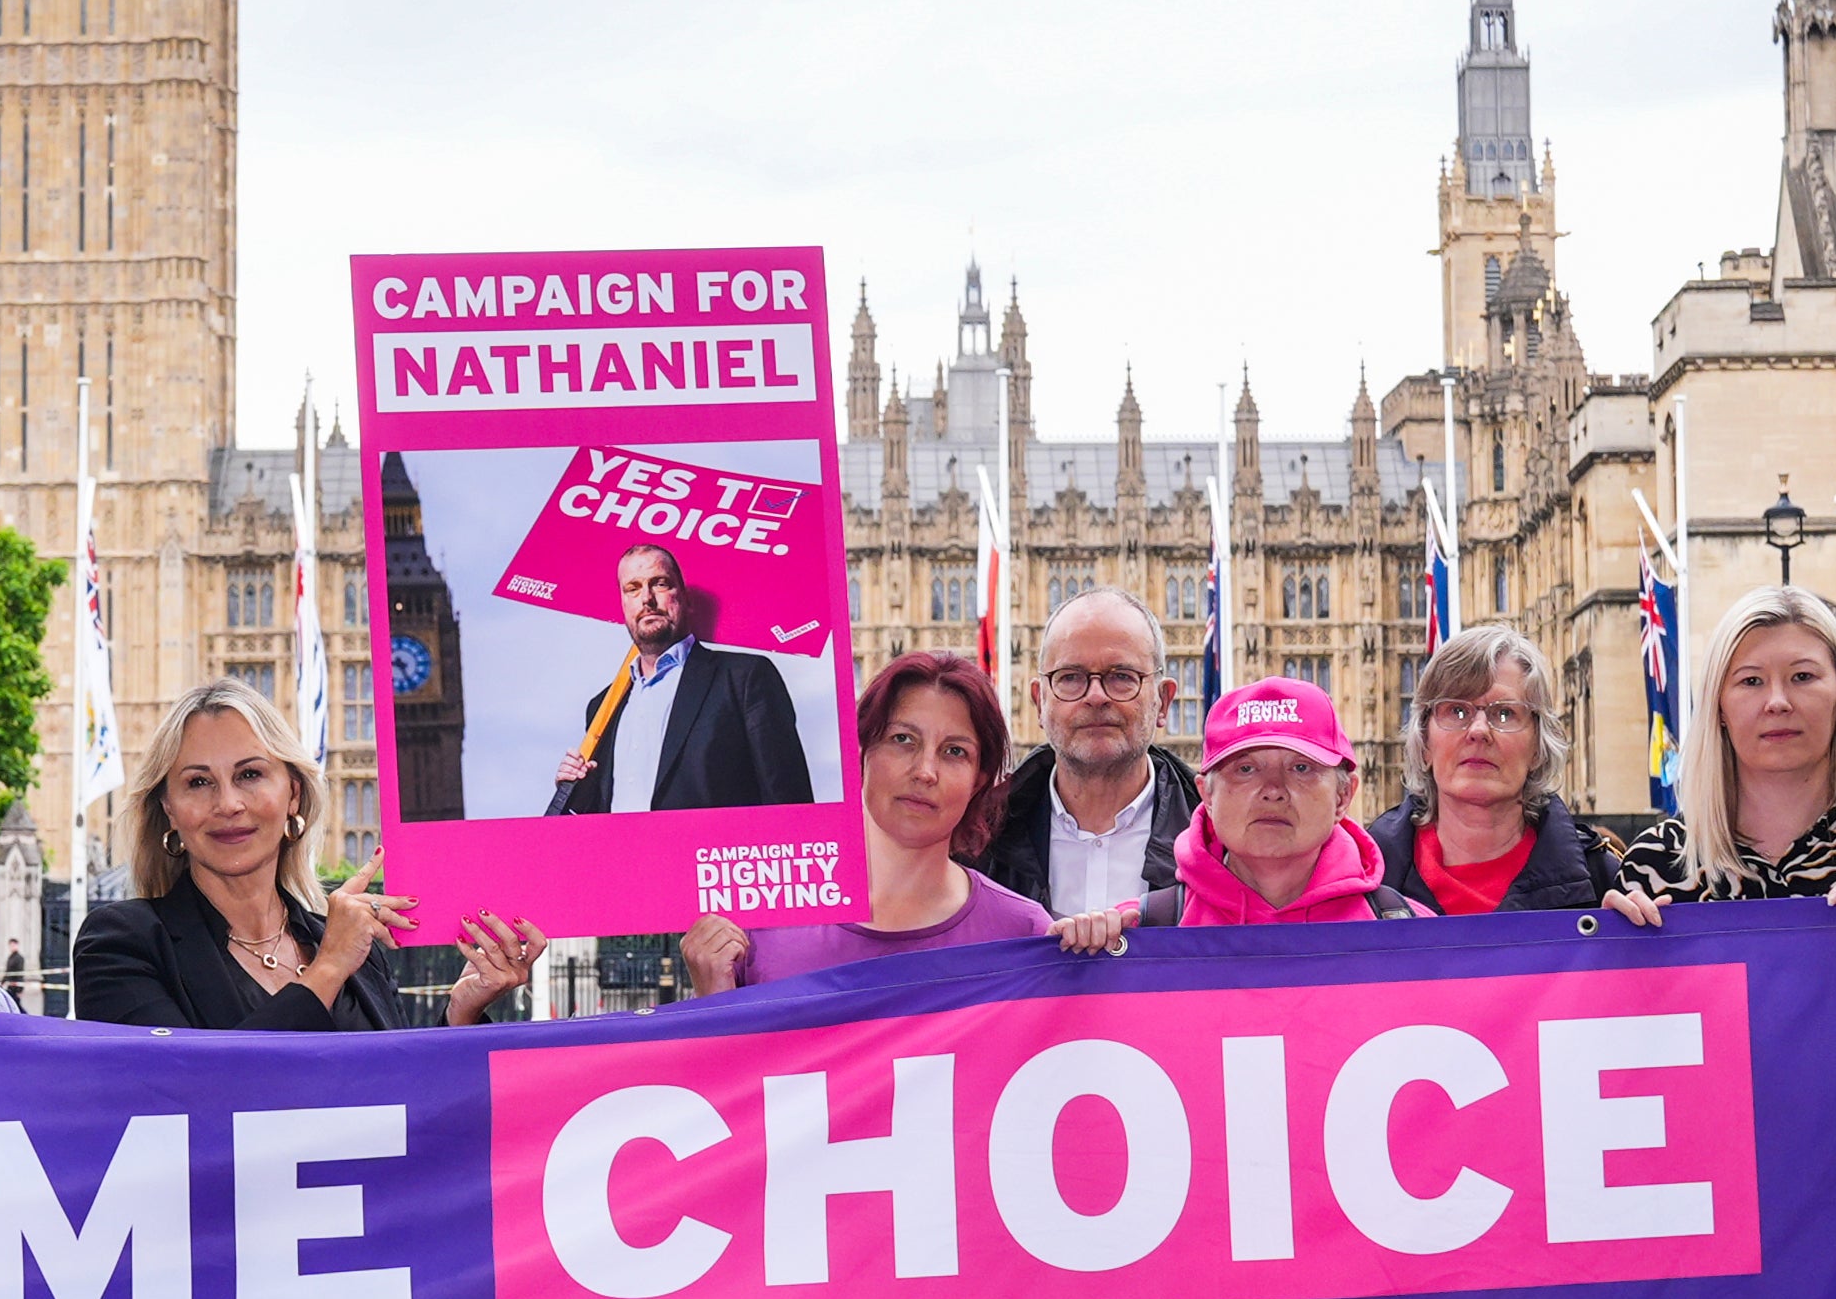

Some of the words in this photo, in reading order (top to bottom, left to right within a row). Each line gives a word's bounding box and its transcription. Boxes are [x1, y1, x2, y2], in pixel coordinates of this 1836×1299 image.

[373, 272, 674, 319] CAMPAIGN
[697, 270, 807, 312] FOR
[393, 338, 799, 397] NATHANIEL
[588, 448, 698, 501] YES
[558, 484, 790, 556] CHOICE.
[1236, 715, 1250, 728] IN
[1251, 713, 1304, 724] DYING.
[1238, 704, 1298, 718] DIGNITY
[696, 844, 794, 862] CAMPAIGN
[801, 842, 839, 857] FOR
[696, 857, 839, 888] DIGNITY
[698, 888, 732, 913] IN
[738, 882, 852, 911] DYING.
[542, 1012, 1714, 1299] CHOICE
